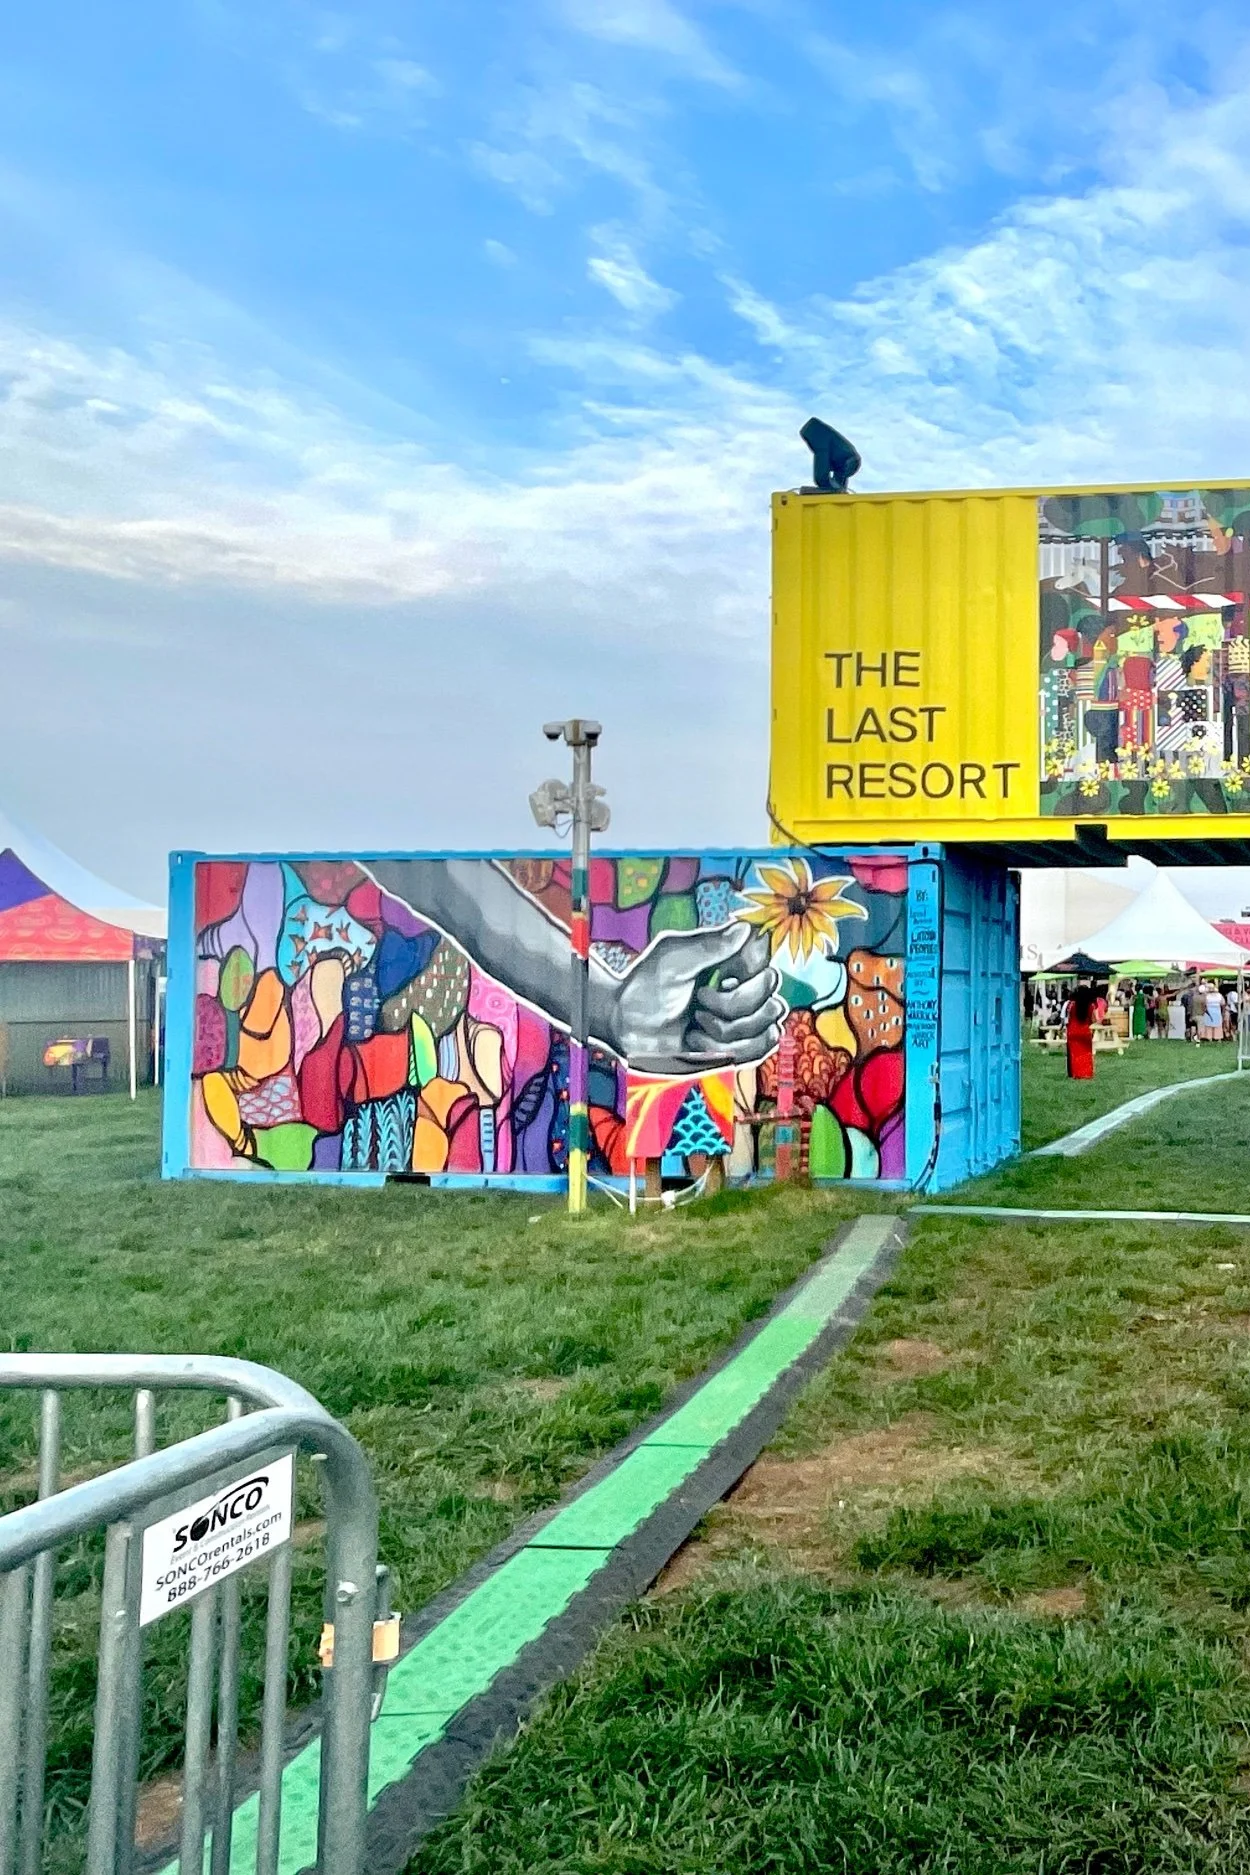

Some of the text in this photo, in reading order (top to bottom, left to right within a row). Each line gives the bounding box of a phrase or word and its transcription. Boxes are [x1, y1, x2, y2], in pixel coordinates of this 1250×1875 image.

[824, 651, 920, 688] THE
[827, 707, 946, 743] LAST
[826, 762, 1020, 799] RESORT
[173, 1486, 263, 1552] SONCO
[155, 1512, 282, 1591] SONCOrentals.com
[168, 1533, 270, 1602] 888-766-2618
